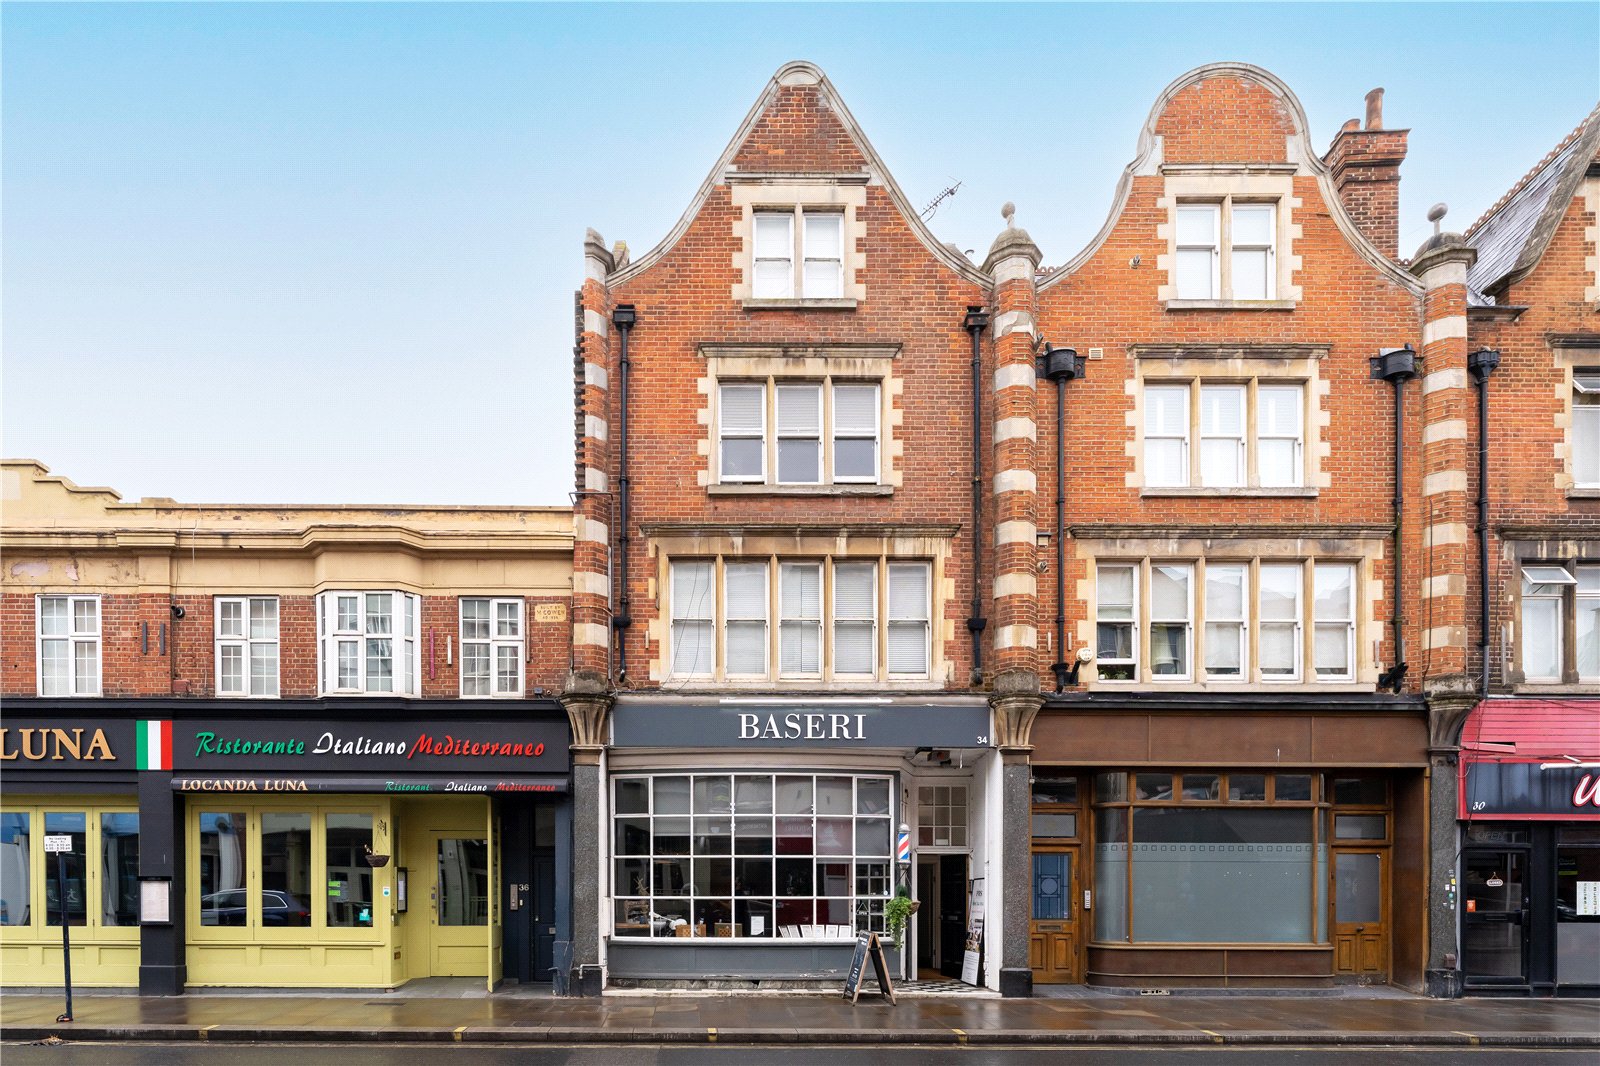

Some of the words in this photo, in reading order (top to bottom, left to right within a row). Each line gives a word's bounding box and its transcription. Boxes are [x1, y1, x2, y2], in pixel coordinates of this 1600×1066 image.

[738, 713, 867, 740] BASERI
[0, 728, 117, 760] LUNA
[976, 735, 988, 744] 34
[195, 731, 305, 757] Ristorante
[311, 731, 407, 755] Italiano
[407, 733, 545, 760] Mediterraneo
[181, 779, 258, 791] LOCANDA
[263, 779, 309, 791] LUNA
[384, 781, 433, 791] Ristorant
[444, 781, 488, 792] Italiano
[494, 781, 557, 792] Mediterraneo
[1472, 801, 1486, 811] 30
[518, 883, 530, 891] 36
